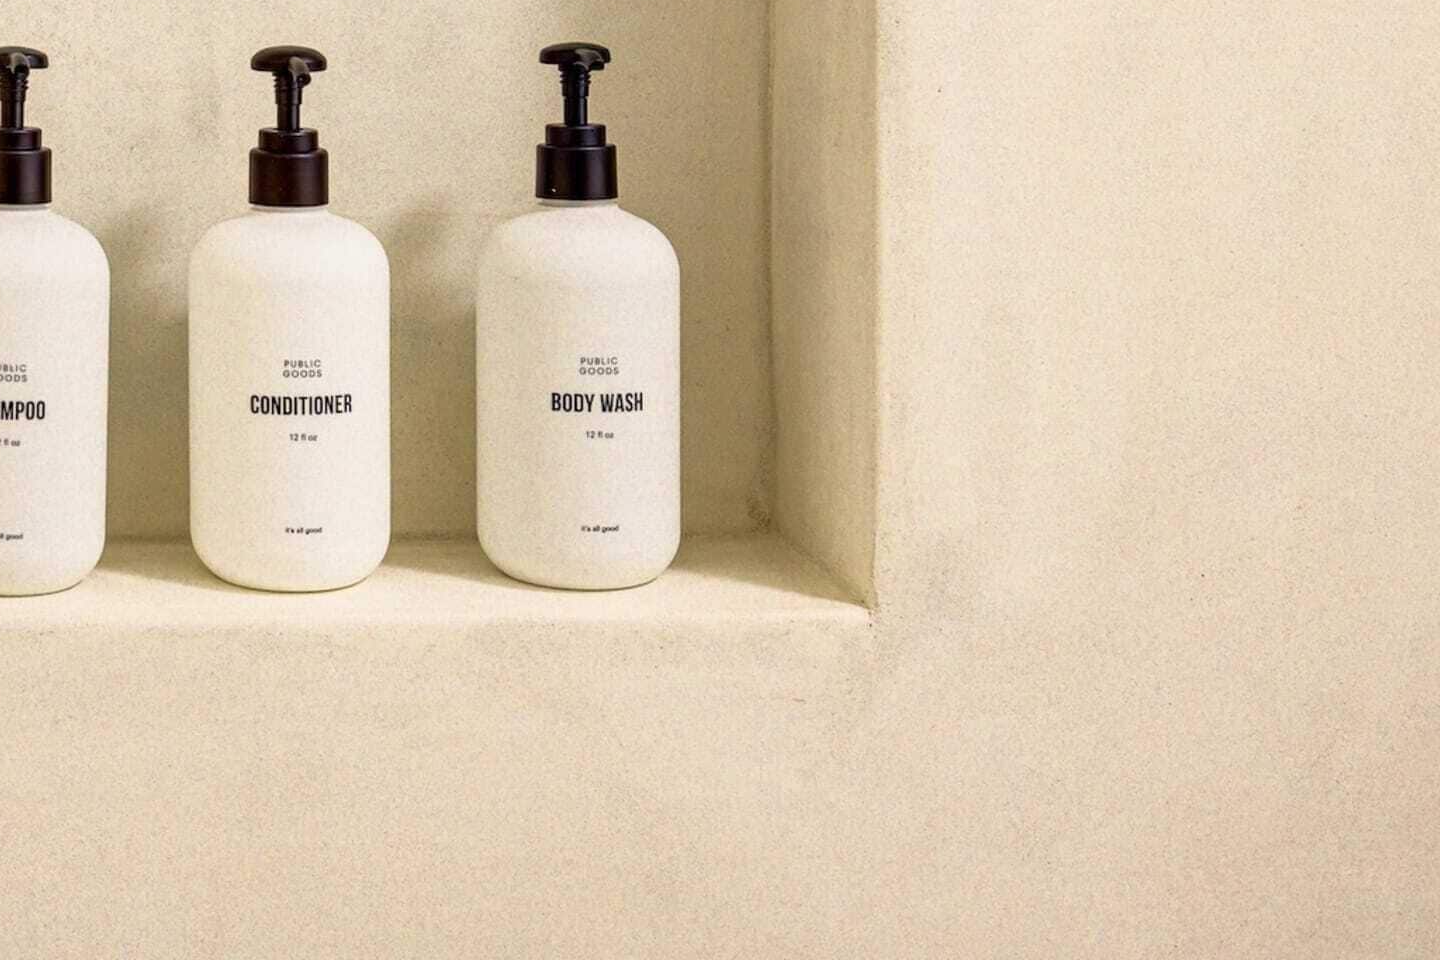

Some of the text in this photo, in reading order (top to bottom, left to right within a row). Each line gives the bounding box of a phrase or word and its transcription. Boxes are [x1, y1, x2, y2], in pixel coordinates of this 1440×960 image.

[283, 359, 321, 368] PUBLIC
[580, 356, 618, 366] PUBLIC
[282, 368, 323, 378] GOODS
[579, 366, 620, 376] GOODS
[250, 393, 353, 416] CONDITIONER
[551, 391, 644, 414] BODY WASH
[289, 433, 299, 442] 12
[308, 434, 318, 442] oz
[585, 430, 596, 440] 12
[605, 432, 615, 440] oz
[11, 439, 21, 447] oz
[296, 526, 304, 535] all
[305, 526, 323, 536] good
[592, 524, 601, 533] all
[601, 524, 620, 534] good
[6, 532, 24, 542] good
